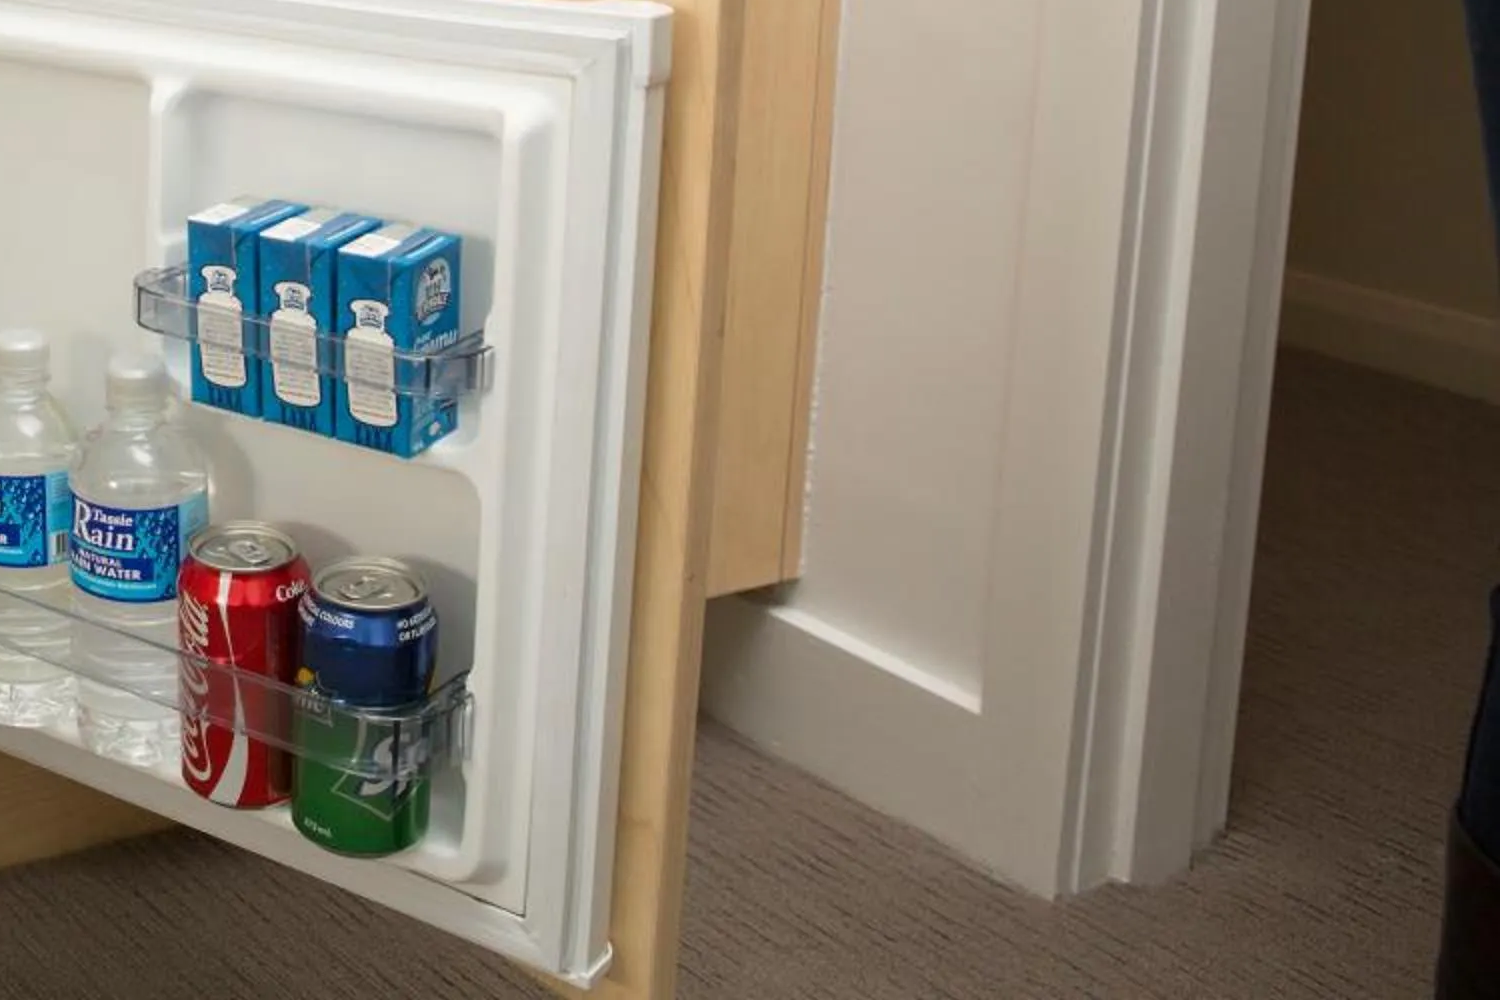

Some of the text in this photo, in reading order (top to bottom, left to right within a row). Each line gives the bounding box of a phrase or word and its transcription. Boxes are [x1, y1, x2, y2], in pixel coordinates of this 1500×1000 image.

[73, 499, 134, 552] Rain
[93, 509, 133, 528] Tassie
[93, 564, 142, 581] WATER
